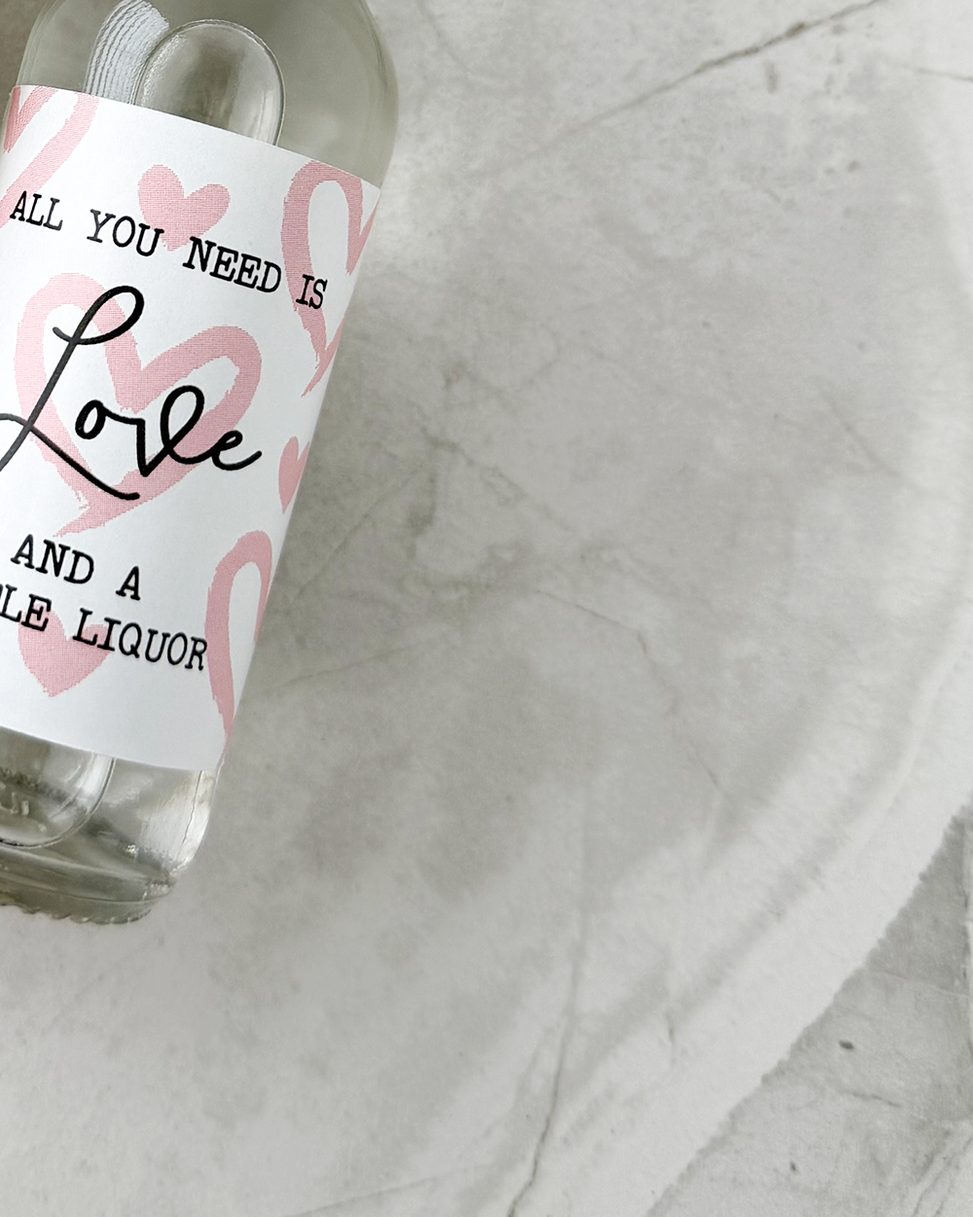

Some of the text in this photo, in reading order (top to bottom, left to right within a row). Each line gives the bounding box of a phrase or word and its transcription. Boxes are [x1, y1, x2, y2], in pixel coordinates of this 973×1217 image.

[8, 189, 329, 311] ALL YOU NEED IS
[10, 533, 142, 602] AND A
[71, 606, 209, 673] LIQUOR
